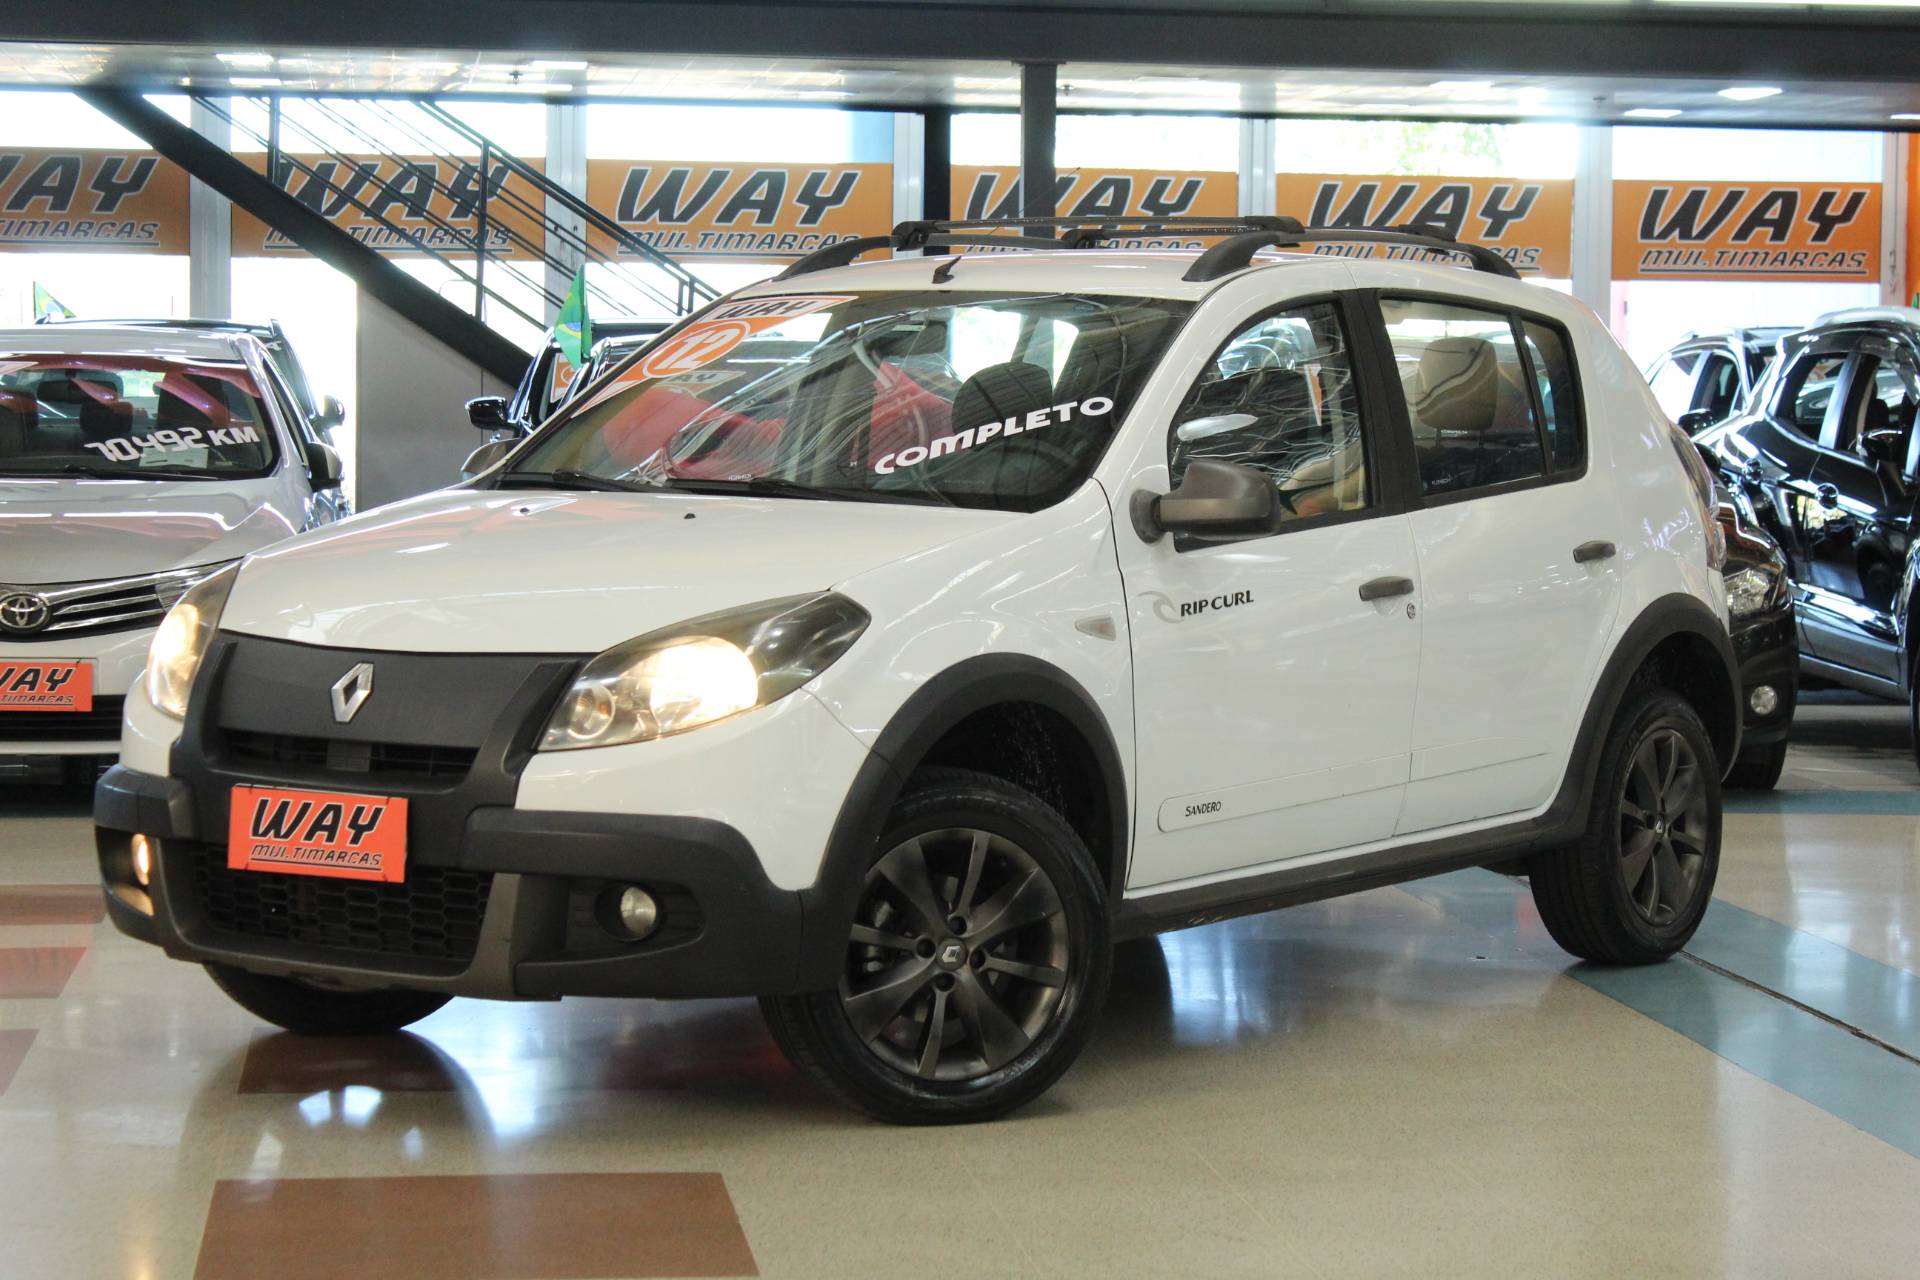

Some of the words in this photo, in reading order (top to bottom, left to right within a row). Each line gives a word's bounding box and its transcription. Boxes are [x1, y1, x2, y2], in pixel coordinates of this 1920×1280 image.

[0, 153, 161, 214] AY
[616, 166, 863, 227] WAY
[1307, 180, 1544, 241] WAY
[1637, 186, 1870, 245] WAY
[0, 219, 160, 239] IMARCAS
[1639, 249, 1868, 268] MULTIMARCAS
[713, 300, 818, 320] WAY
[653, 328, 740, 370] 12
[207, 426, 261, 446] KM
[874, 396, 1114, 475] COMPLETO
[1180, 599, 1208, 617] RIP
[1211, 590, 1254, 610] CURL
[0, 666, 76, 692] AY
[250, 797, 387, 847] WAY
[1185, 801, 1222, 817] SANDERO
[251, 844, 383, 866] MULTIMARCAS
